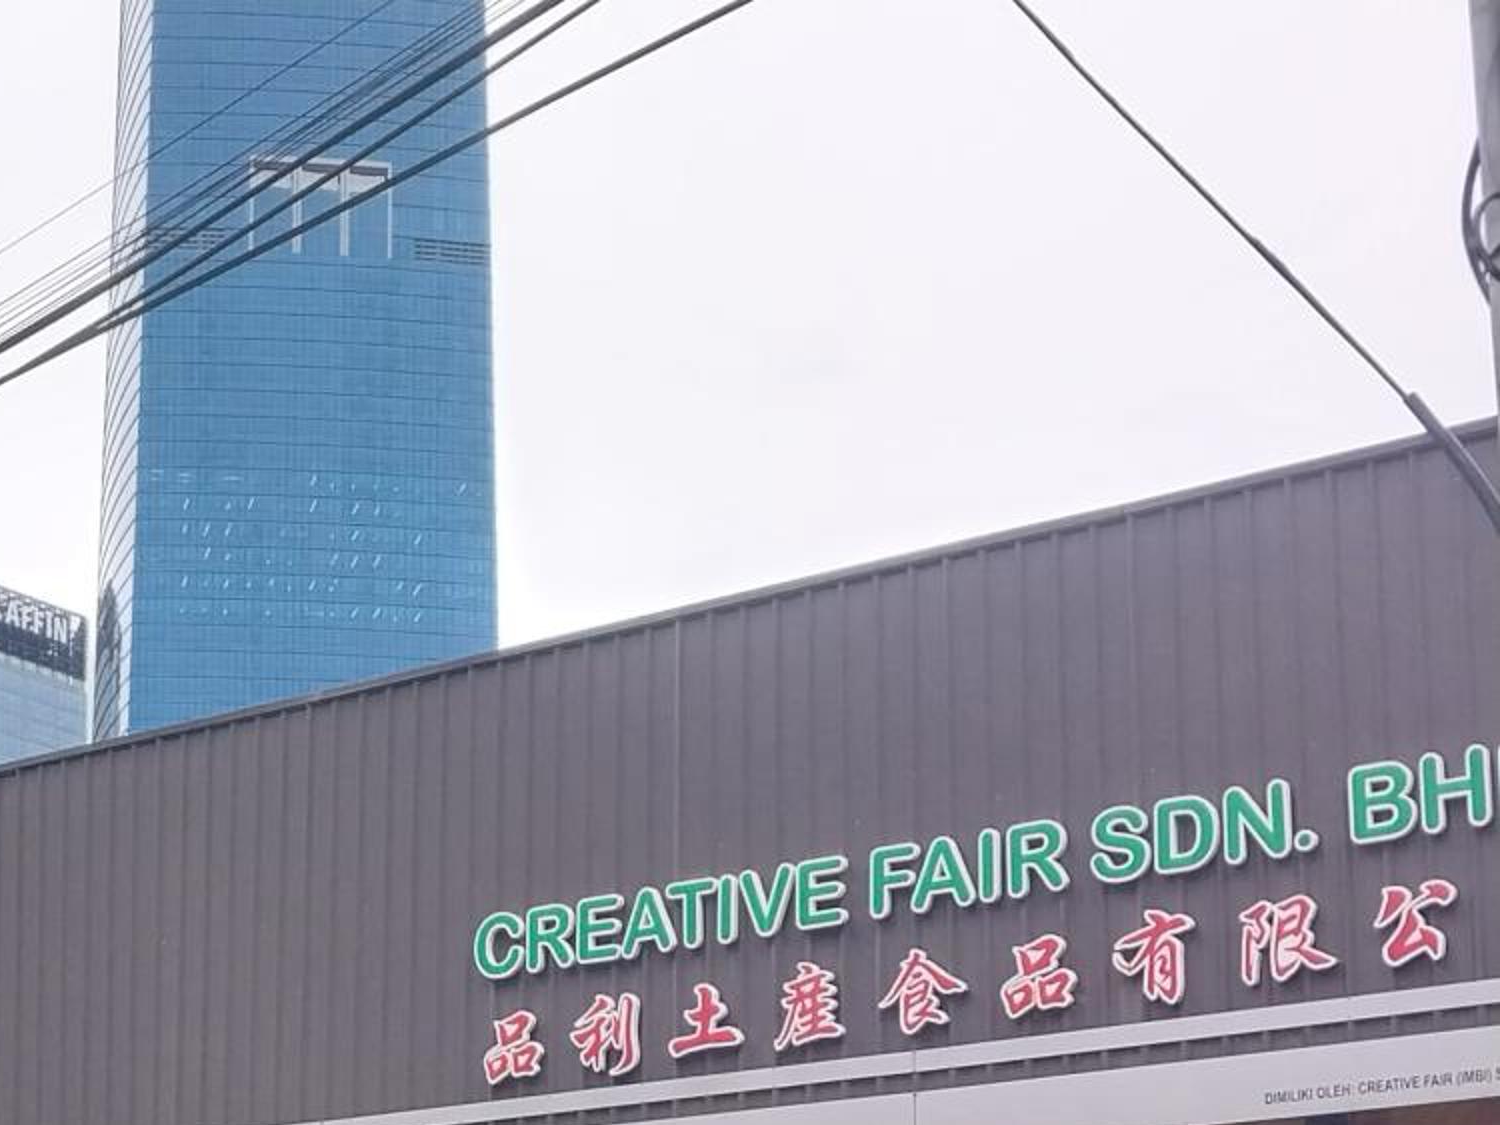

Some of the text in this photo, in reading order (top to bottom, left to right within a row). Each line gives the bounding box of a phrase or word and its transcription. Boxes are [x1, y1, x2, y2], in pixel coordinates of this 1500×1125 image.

[5, 599, 68, 645] AFFIN
[473, 743, 1500, 979] CREATIVE FAIR SDN. BH
[1264, 1088, 1313, 1105] DIMILIKI
[1358, 1075, 1421, 1095] CREATIVE
[1424, 1071, 1453, 1087] FAIR
